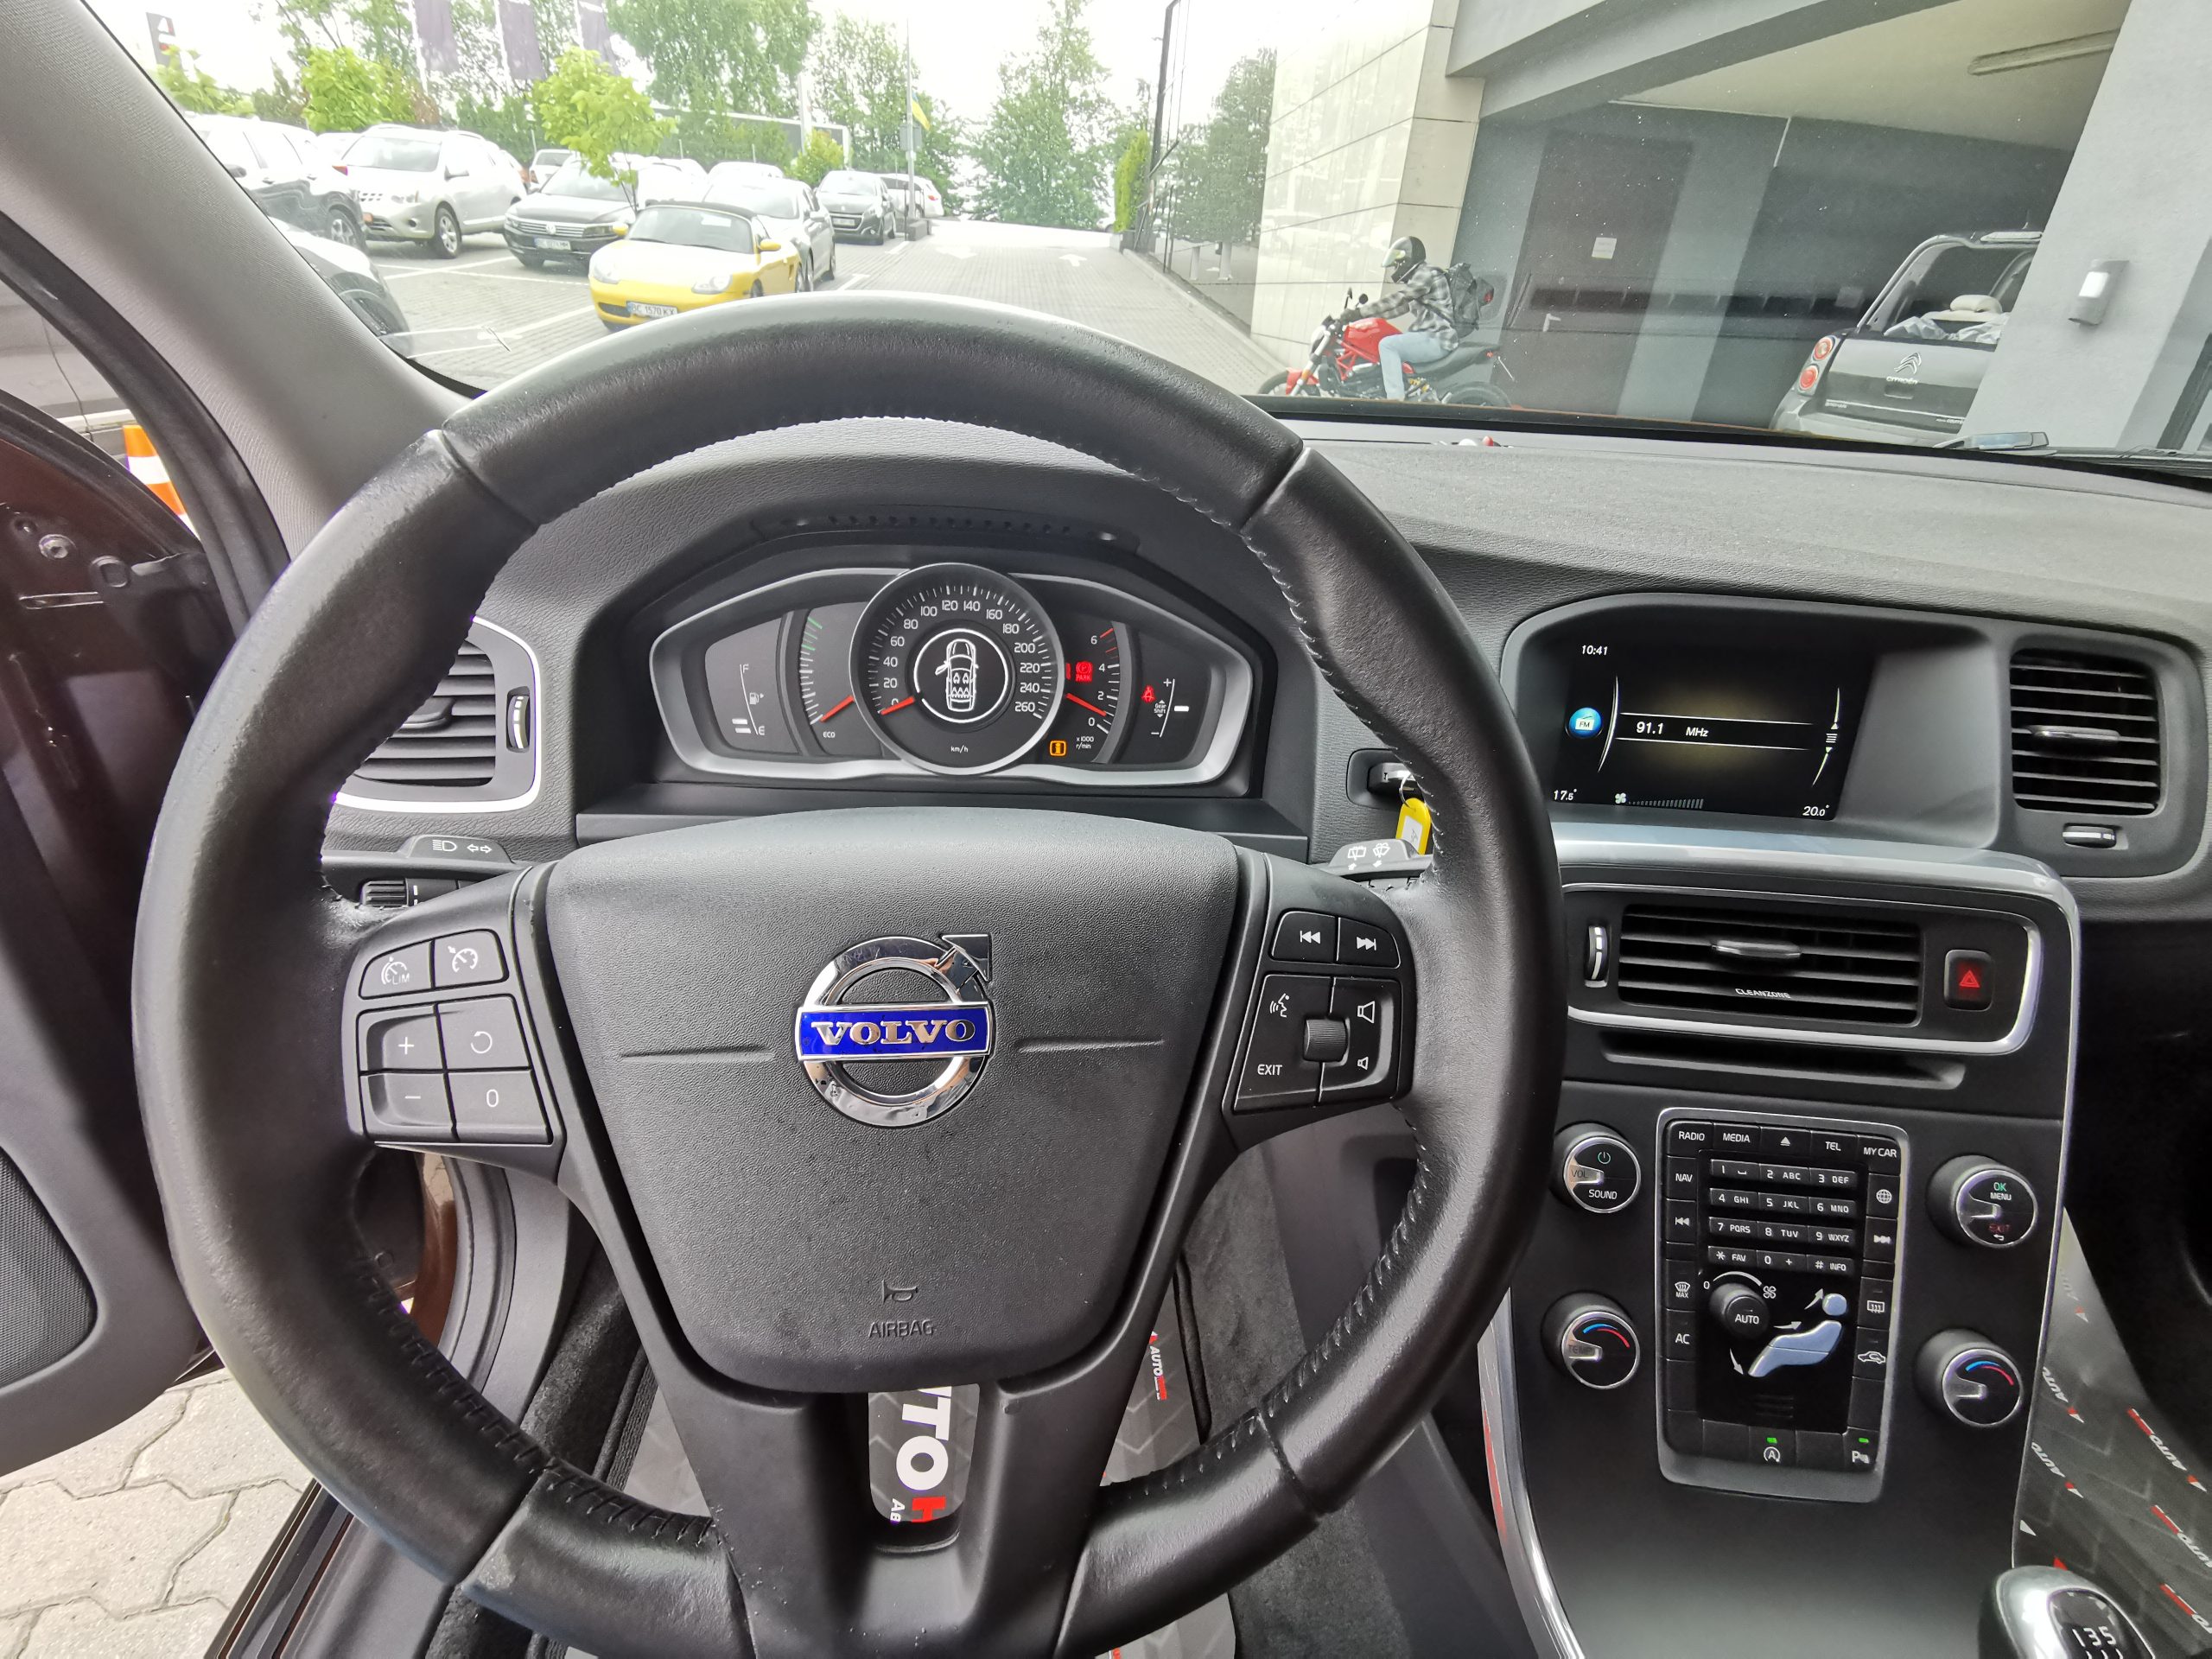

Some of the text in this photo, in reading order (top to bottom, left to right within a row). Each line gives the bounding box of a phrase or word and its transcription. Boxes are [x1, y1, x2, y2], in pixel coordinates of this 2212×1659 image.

[942, 600, 958, 611] 120
[963, 601, 981, 612] 140
[920, 606, 938, 617] 100
[986, 609, 1003, 620] 160
[903, 619, 918, 630] 80
[1002, 623, 1020, 634] 180
[890, 636, 905, 647] 60
[1090, 635, 1097, 645] 6
[1014, 642, 1036, 653] 200
[1580, 645, 1609, 657] 10:41
[883, 657, 899, 668] 40
[1020, 663, 1040, 673] 220
[1098, 663, 1105, 672] 4
[883, 677, 898, 689] 20
[1020, 682, 1040, 693] 240
[1097, 691, 1104, 701] 2
[1014, 701, 1036, 713] 260
[1088, 717, 1096, 727] 0
[1579, 720, 1591, 728] FM
[1636, 721, 1709, 738] 91.1 MHz
[950, 745, 969, 753] km/h
[392, 972, 410, 986] LIM
[1734, 988, 1791, 999] CLEANZONE
[810, 1019, 976, 1046] VOLVO
[1257, 1064, 1283, 1076] EXIT
[1678, 1130, 1705, 1141] RADIO
[1722, 1132, 1751, 1143] MEDIA
[1825, 1141, 1841, 1152] TEL
[1675, 1172, 1693, 1183] NAV
[1783, 1172, 1802, 1181] ABC
[1832, 1176, 1849, 1185] DEF
[1993, 1181, 2007, 1192] OK
[1588, 1188, 1618, 1200] SOUND
[1990, 1192, 2012, 1201] MENU
[1733, 1195, 1749, 1205] GHI
[1783, 1200, 1800, 1210] JKL
[1830, 1205, 1849, 1213] MNO
[1730, 1224, 1751, 1234] PQRS
[1780, 1229, 1799, 1238] TUV
[1827, 1233, 1850, 1243] WXYZ
[1732, 1253, 1746, 1263] FAV
[1829, 1262, 1847, 1272] INFO
[1734, 1313, 1760, 1325] AUTO
[868, 1319, 936, 1338] AIRBAG
[1675, 1332, 1690, 1345] AC
